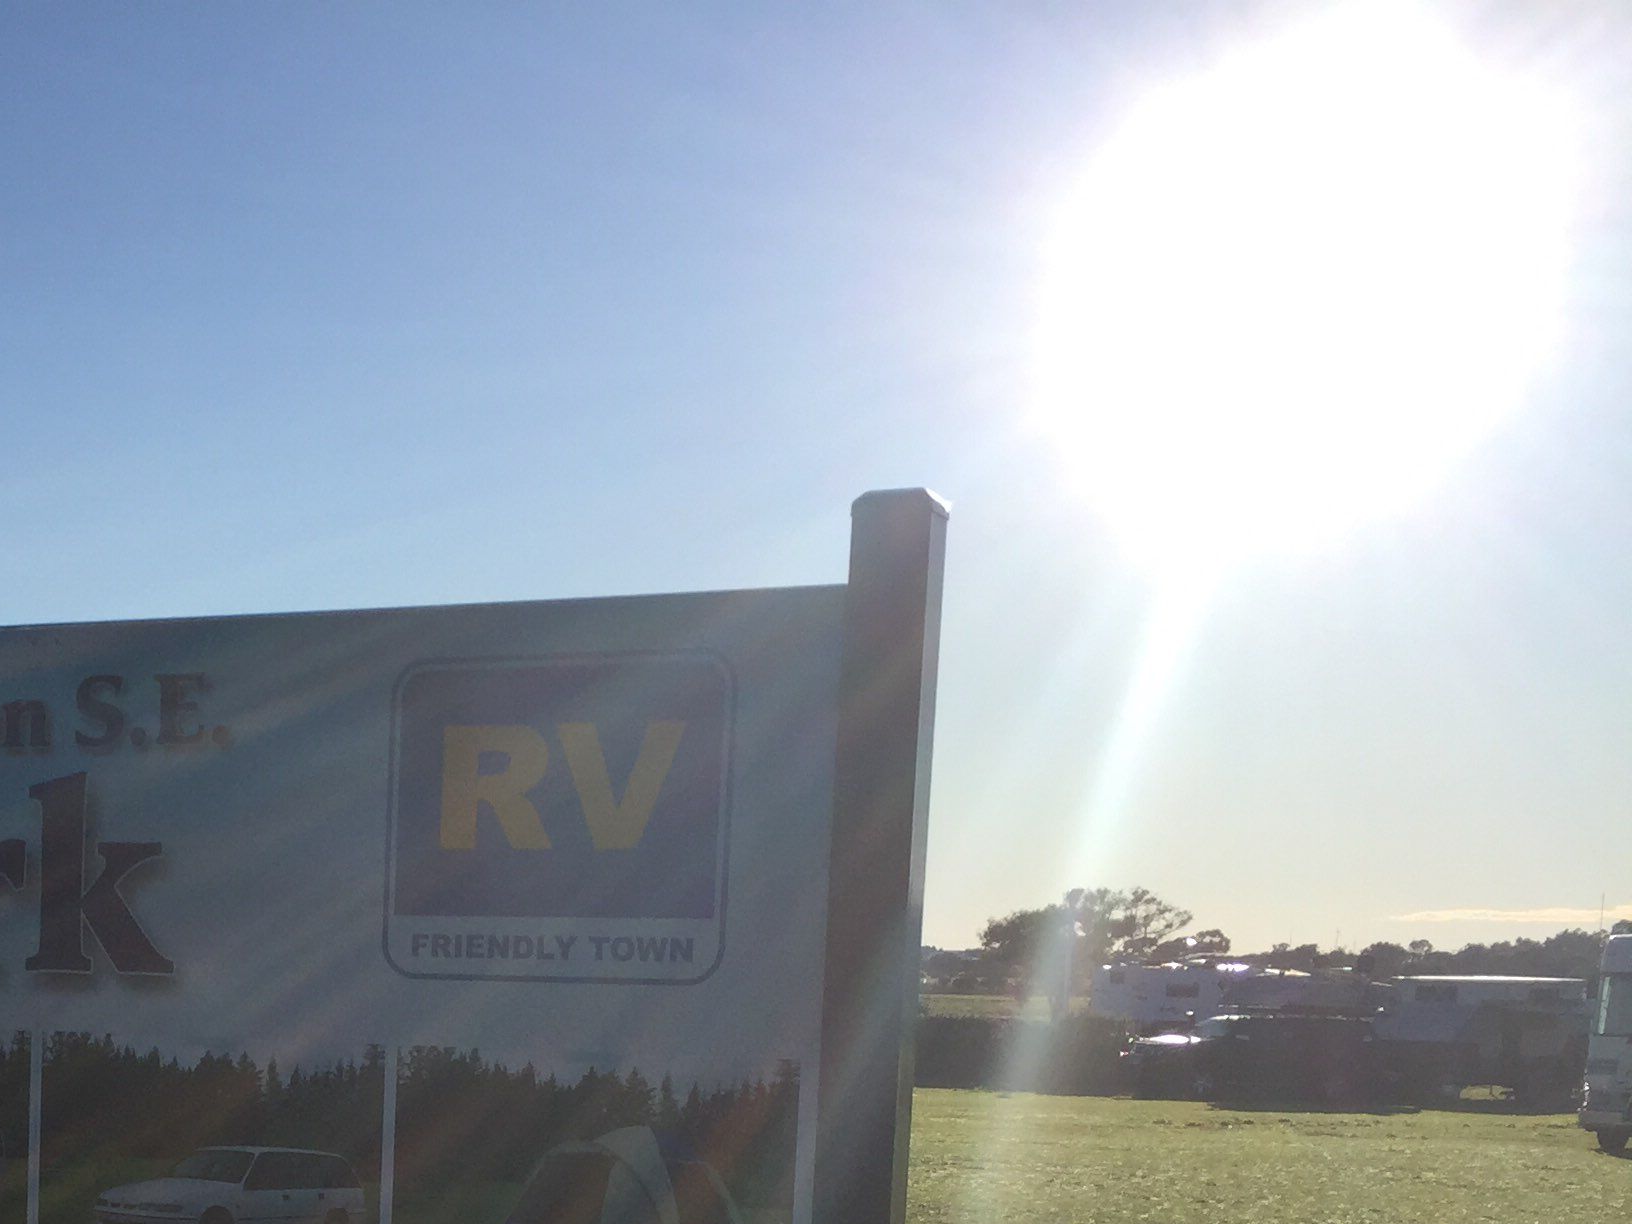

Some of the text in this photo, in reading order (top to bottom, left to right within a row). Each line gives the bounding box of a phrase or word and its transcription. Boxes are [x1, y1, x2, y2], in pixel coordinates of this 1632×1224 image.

[75, 672, 231, 747] S.E.
[439, 720, 686, 850] RV
[411, 934, 694, 962] FRIENDLY TOWN
